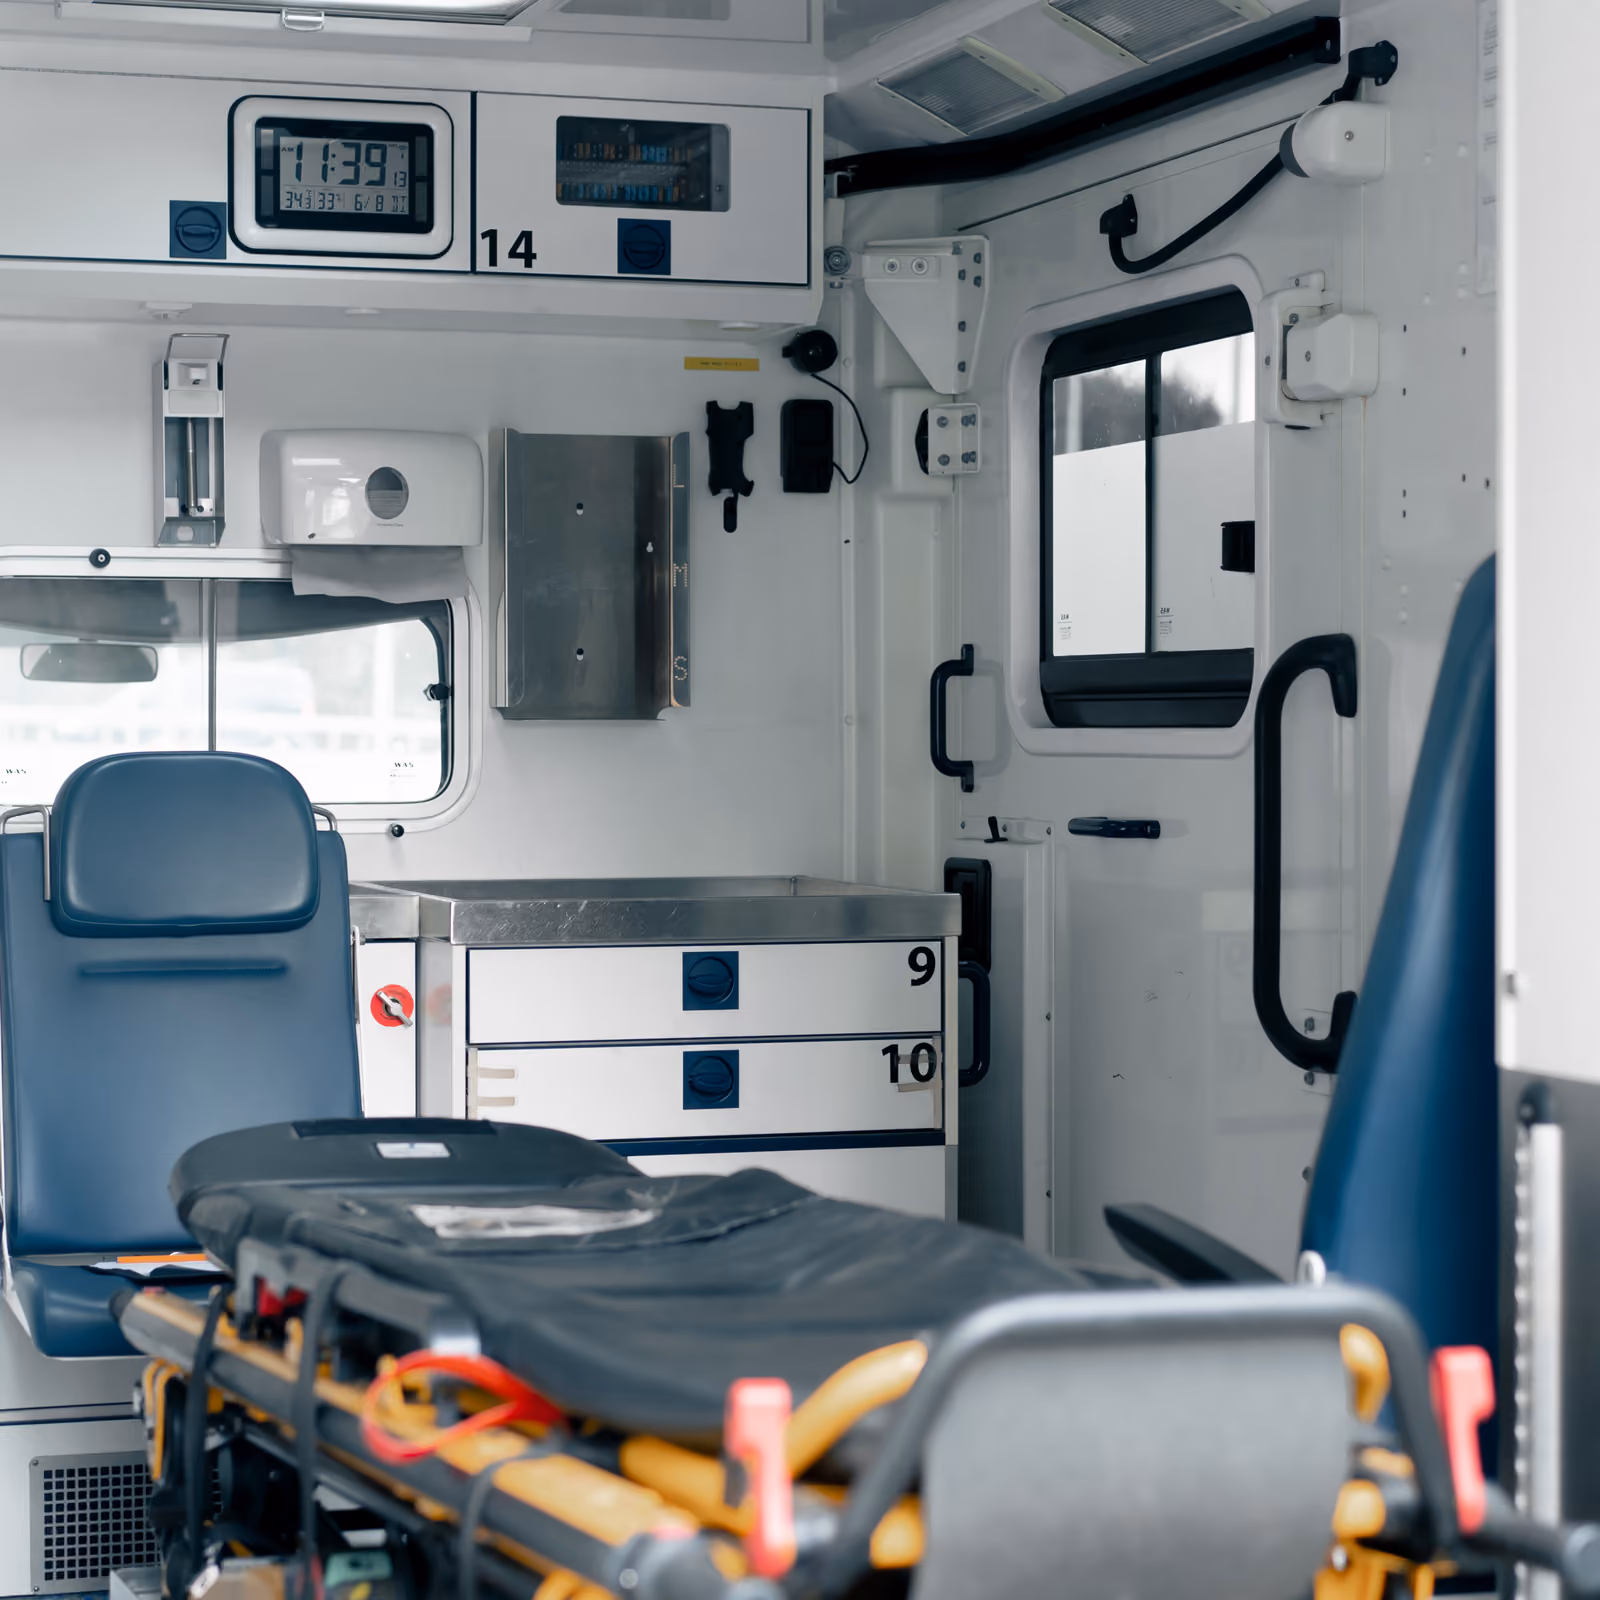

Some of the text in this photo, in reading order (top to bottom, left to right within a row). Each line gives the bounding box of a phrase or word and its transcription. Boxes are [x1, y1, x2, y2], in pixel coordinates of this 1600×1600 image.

[295, 141, 387, 186] 11:39
[394, 169, 407, 188] 13
[480, 229, 537, 268] 14
[673, 563, 688, 588] M
[674, 656, 688, 681] S
[908, 946, 935, 986] 9
[881, 1042, 938, 1083] 10
